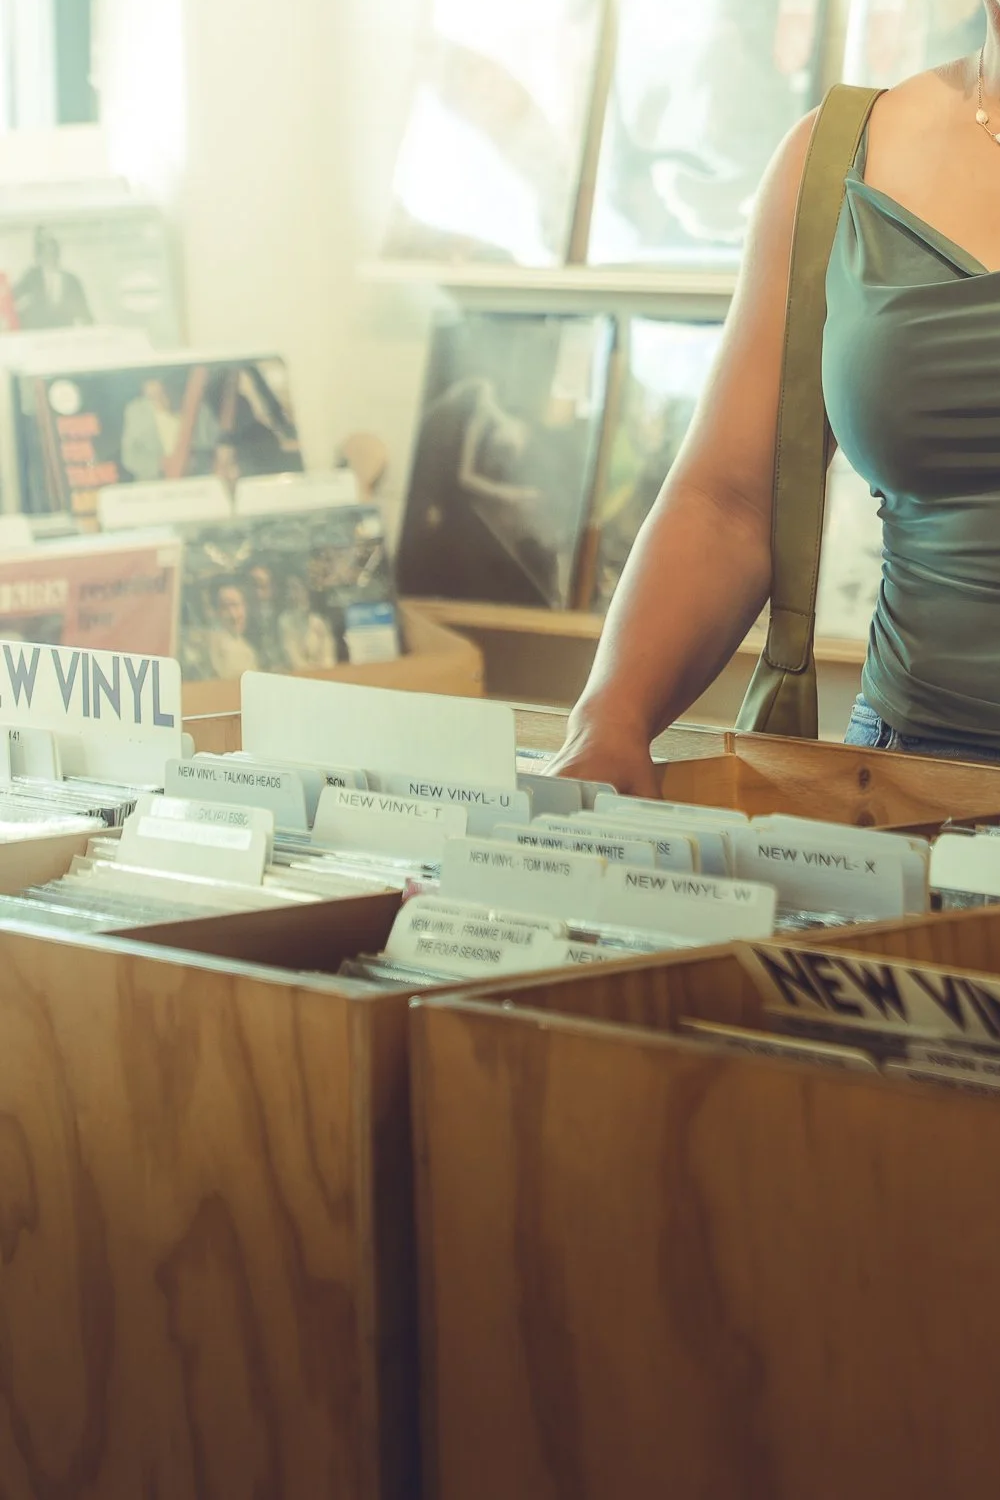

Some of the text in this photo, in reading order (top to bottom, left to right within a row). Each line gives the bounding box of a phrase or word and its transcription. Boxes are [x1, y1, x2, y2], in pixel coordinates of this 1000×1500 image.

[51, 648, 175, 728] VINYL
[178, 765, 195, 778] NEW
[196, 767, 217, 782] VINYL
[224, 770, 255, 786] TALKING
[255, 775, 281, 789] HEADS
[338, 792, 375, 808] NEW
[433, 807, 443, 819] T
[408, 782, 443, 798] NEW
[500, 794, 511, 808] U
[516, 834, 538, 846] NEW
[596, 844, 625, 860] WHITE
[757, 843, 797, 863] NEW
[864, 859, 877, 875] X
[469, 850, 489, 864] NEW
[491, 853, 513, 869] VINYL
[523, 858, 541, 872] TOM
[543, 860, 571, 877] WAITS
[625, 873, 667, 891] NEW
[734, 887, 751, 902] W
[410, 917, 430, 931] NEW
[431, 920, 455, 936] VINYL
[461, 924, 499, 941] FRANKIE
[500, 929, 525, 945] VALLI
[416, 939, 501, 963] THE FOUR SEASONS
[751, 945, 908, 1024] NEW
